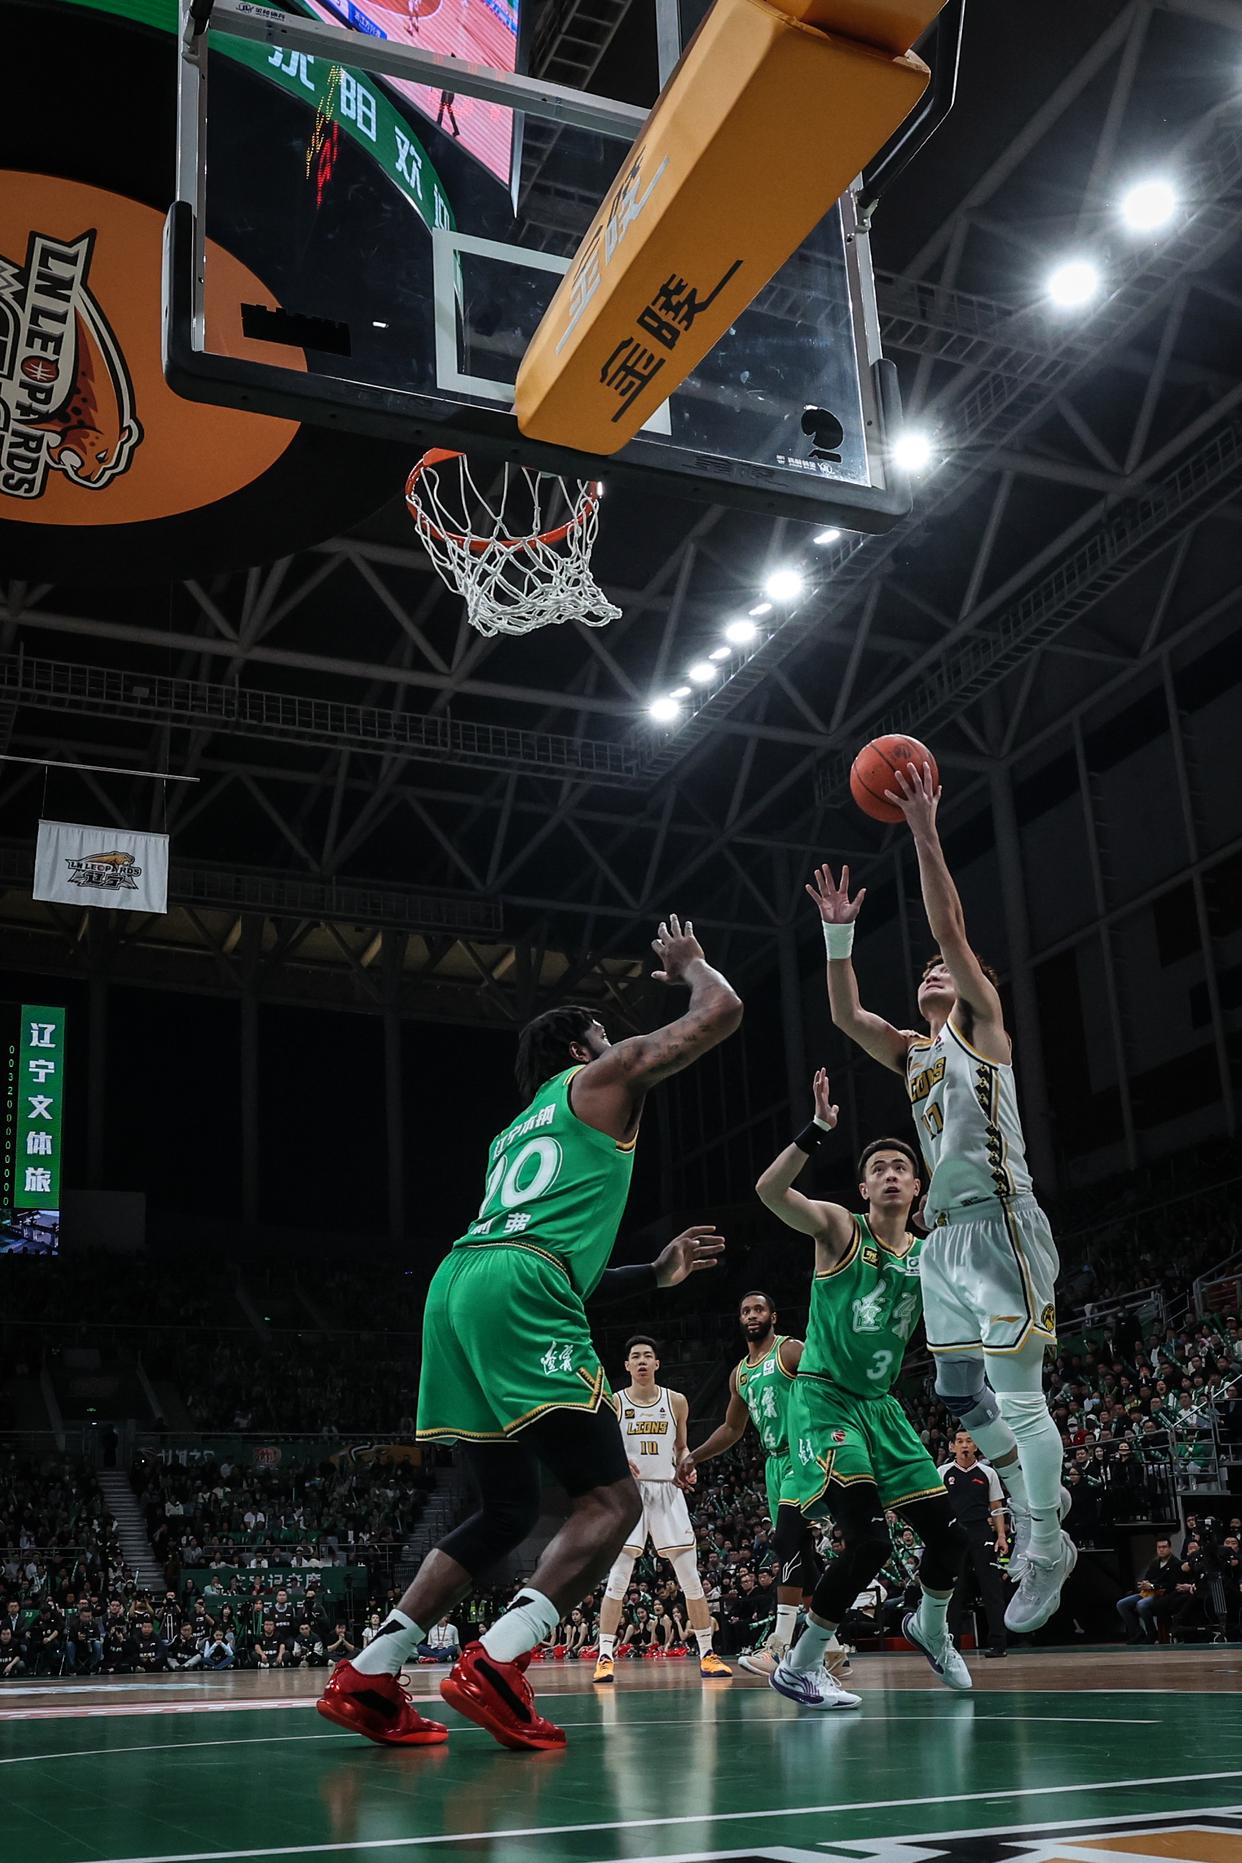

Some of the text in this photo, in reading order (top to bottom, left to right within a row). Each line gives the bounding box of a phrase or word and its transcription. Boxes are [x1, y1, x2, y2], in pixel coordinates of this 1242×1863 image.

[2, 244, 79, 495] LN LEOPARDS
[85, 862, 140, 875] LEOPARDS
[24, 1022, 57, 1193] 辽宁文体旅
[921, 1102, 944, 1141] 17
[866, 1349, 894, 1380] 3
[627, 1421, 669, 1436] LIONS
[764, 1425, 777, 1448] 4
[640, 1440, 659, 1455] 10
